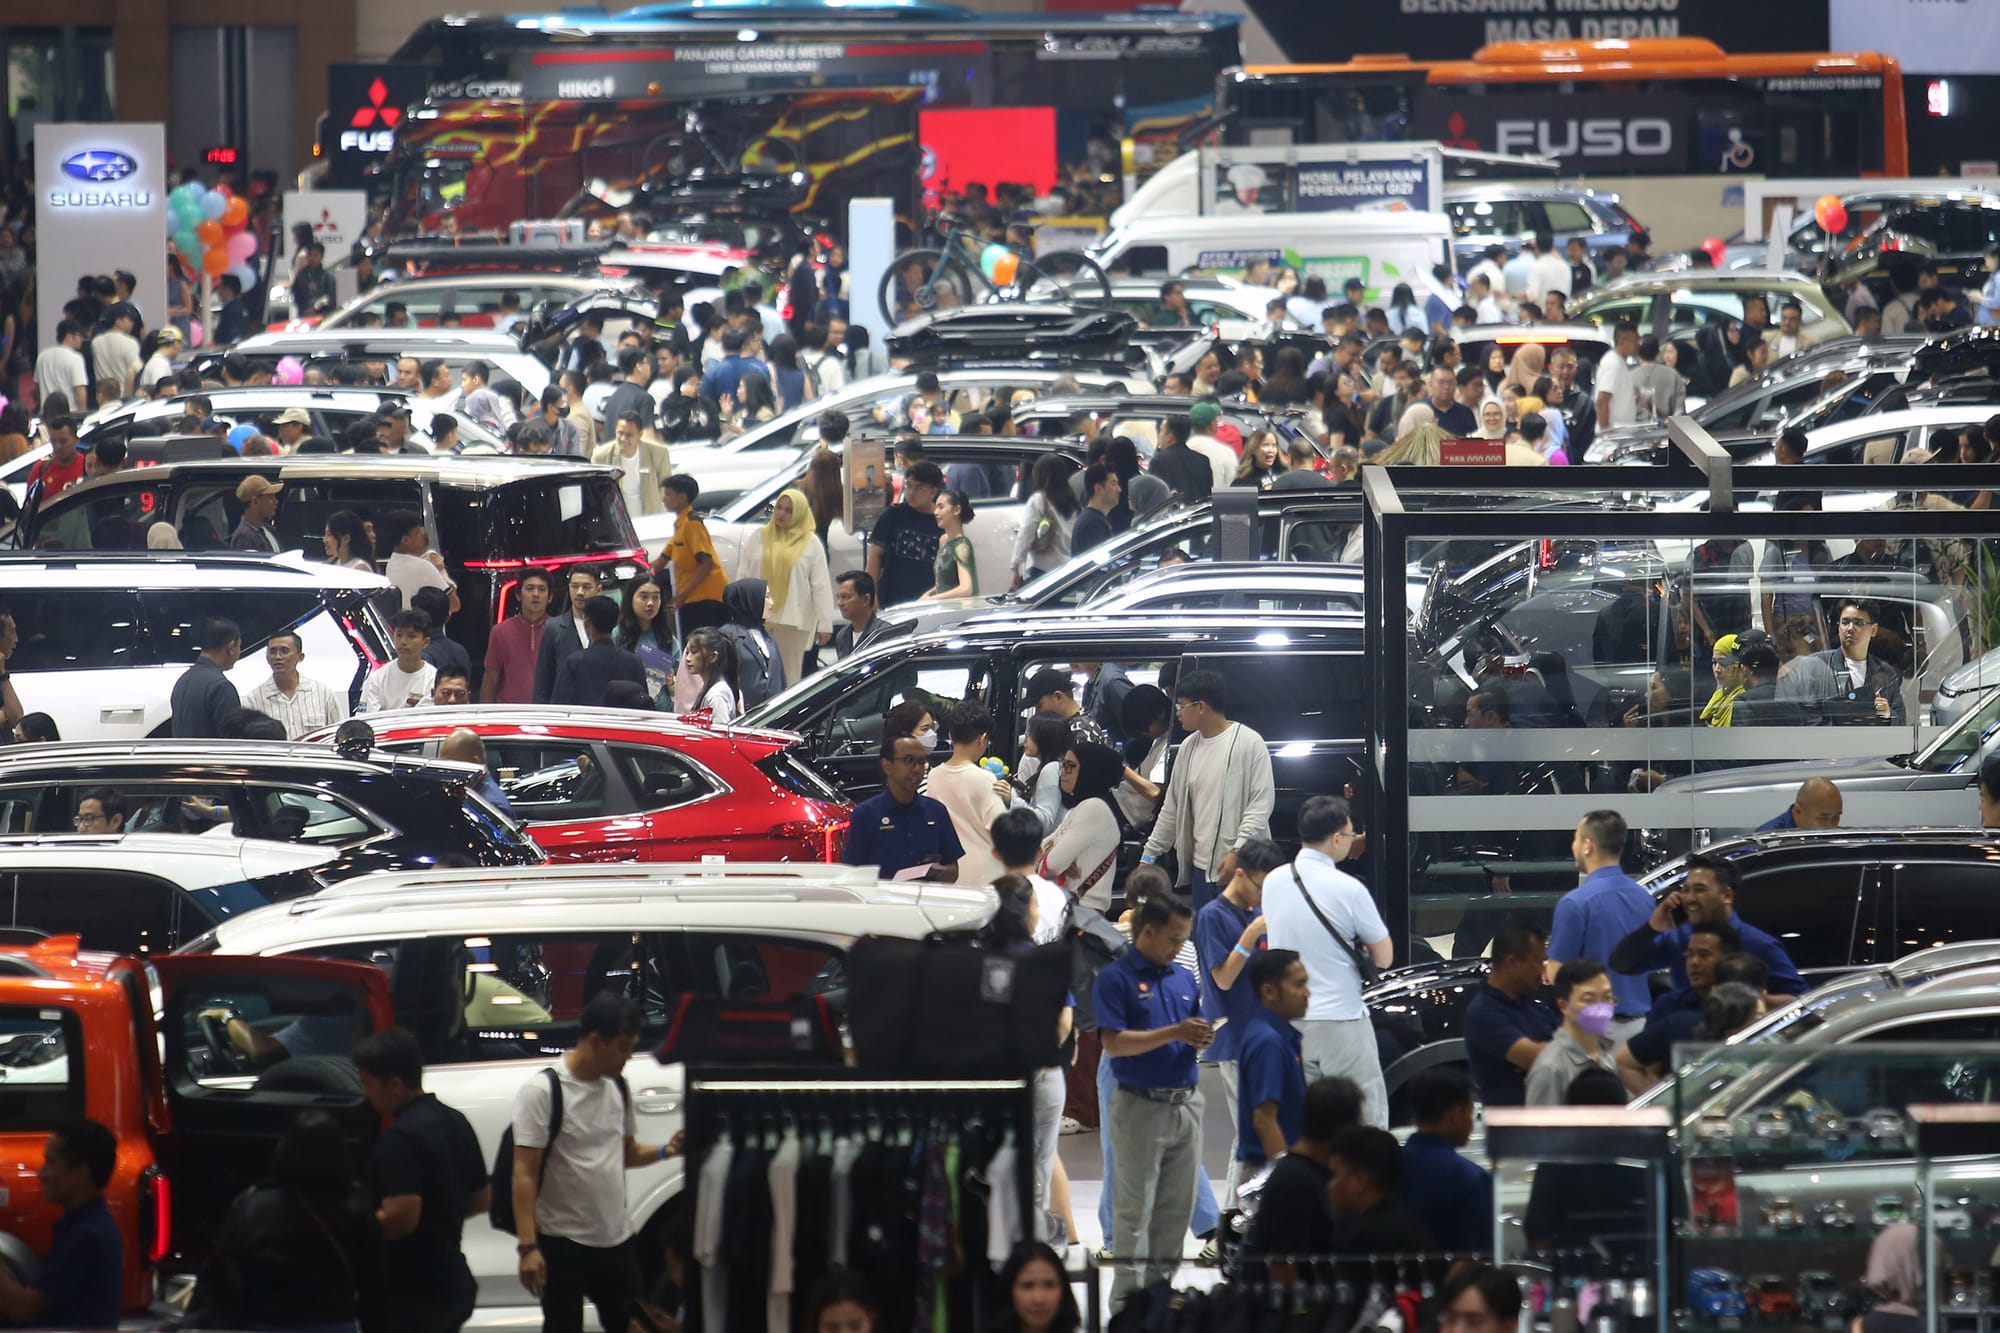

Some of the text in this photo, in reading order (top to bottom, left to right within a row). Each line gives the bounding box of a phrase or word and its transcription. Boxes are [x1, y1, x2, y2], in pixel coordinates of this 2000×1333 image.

[1485, 18, 1680, 44] MASA DEPAN
[674, 48, 735, 61] PANJANG
[737, 47, 786, 60] CARGO
[797, 45, 842, 59] METER
[558, 81, 601, 98] HINO
[1496, 119, 1672, 157] FUSO
[1298, 169, 1423, 185] MOBIL PELAYANAN
[1298, 184, 1384, 197] PEMENUHAN
[50, 192, 151, 207] SUBARU
